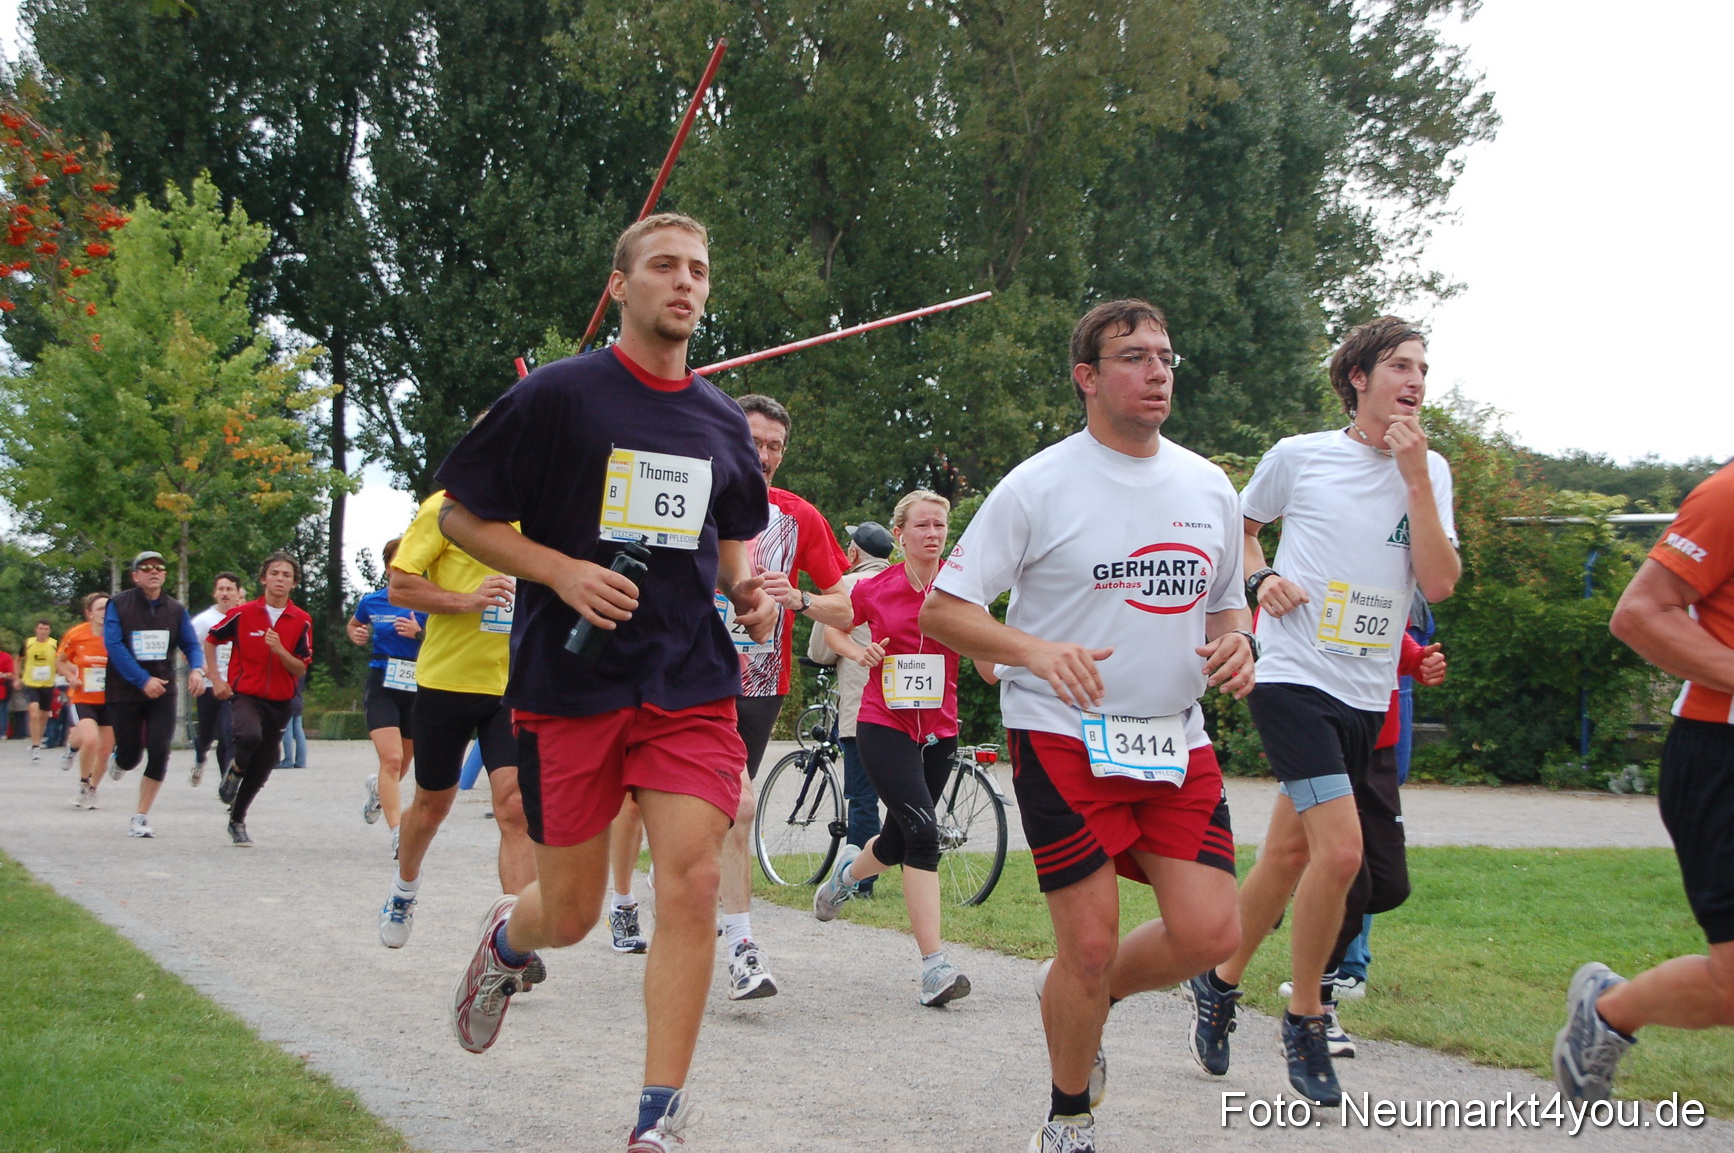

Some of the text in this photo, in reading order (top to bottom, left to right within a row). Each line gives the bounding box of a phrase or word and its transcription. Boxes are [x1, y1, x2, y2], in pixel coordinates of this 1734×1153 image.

[640, 461, 689, 483] Thomas
[610, 485, 617, 498] B
[655, 493, 686, 518] 63
[1093, 560, 1207, 580] GERHART &
[1094, 580, 1142, 590] Autohaus
[1142, 578, 1207, 596] JÄNIG
[1350, 590, 1393, 609] Matthias
[1326, 608, 1332, 618] B
[1354, 615, 1389, 636] 502
[897, 660, 926, 670] Nadine
[904, 676, 932, 690] 751
[1089, 730, 1097, 741] B
[1115, 733, 1176, 756] 3414
